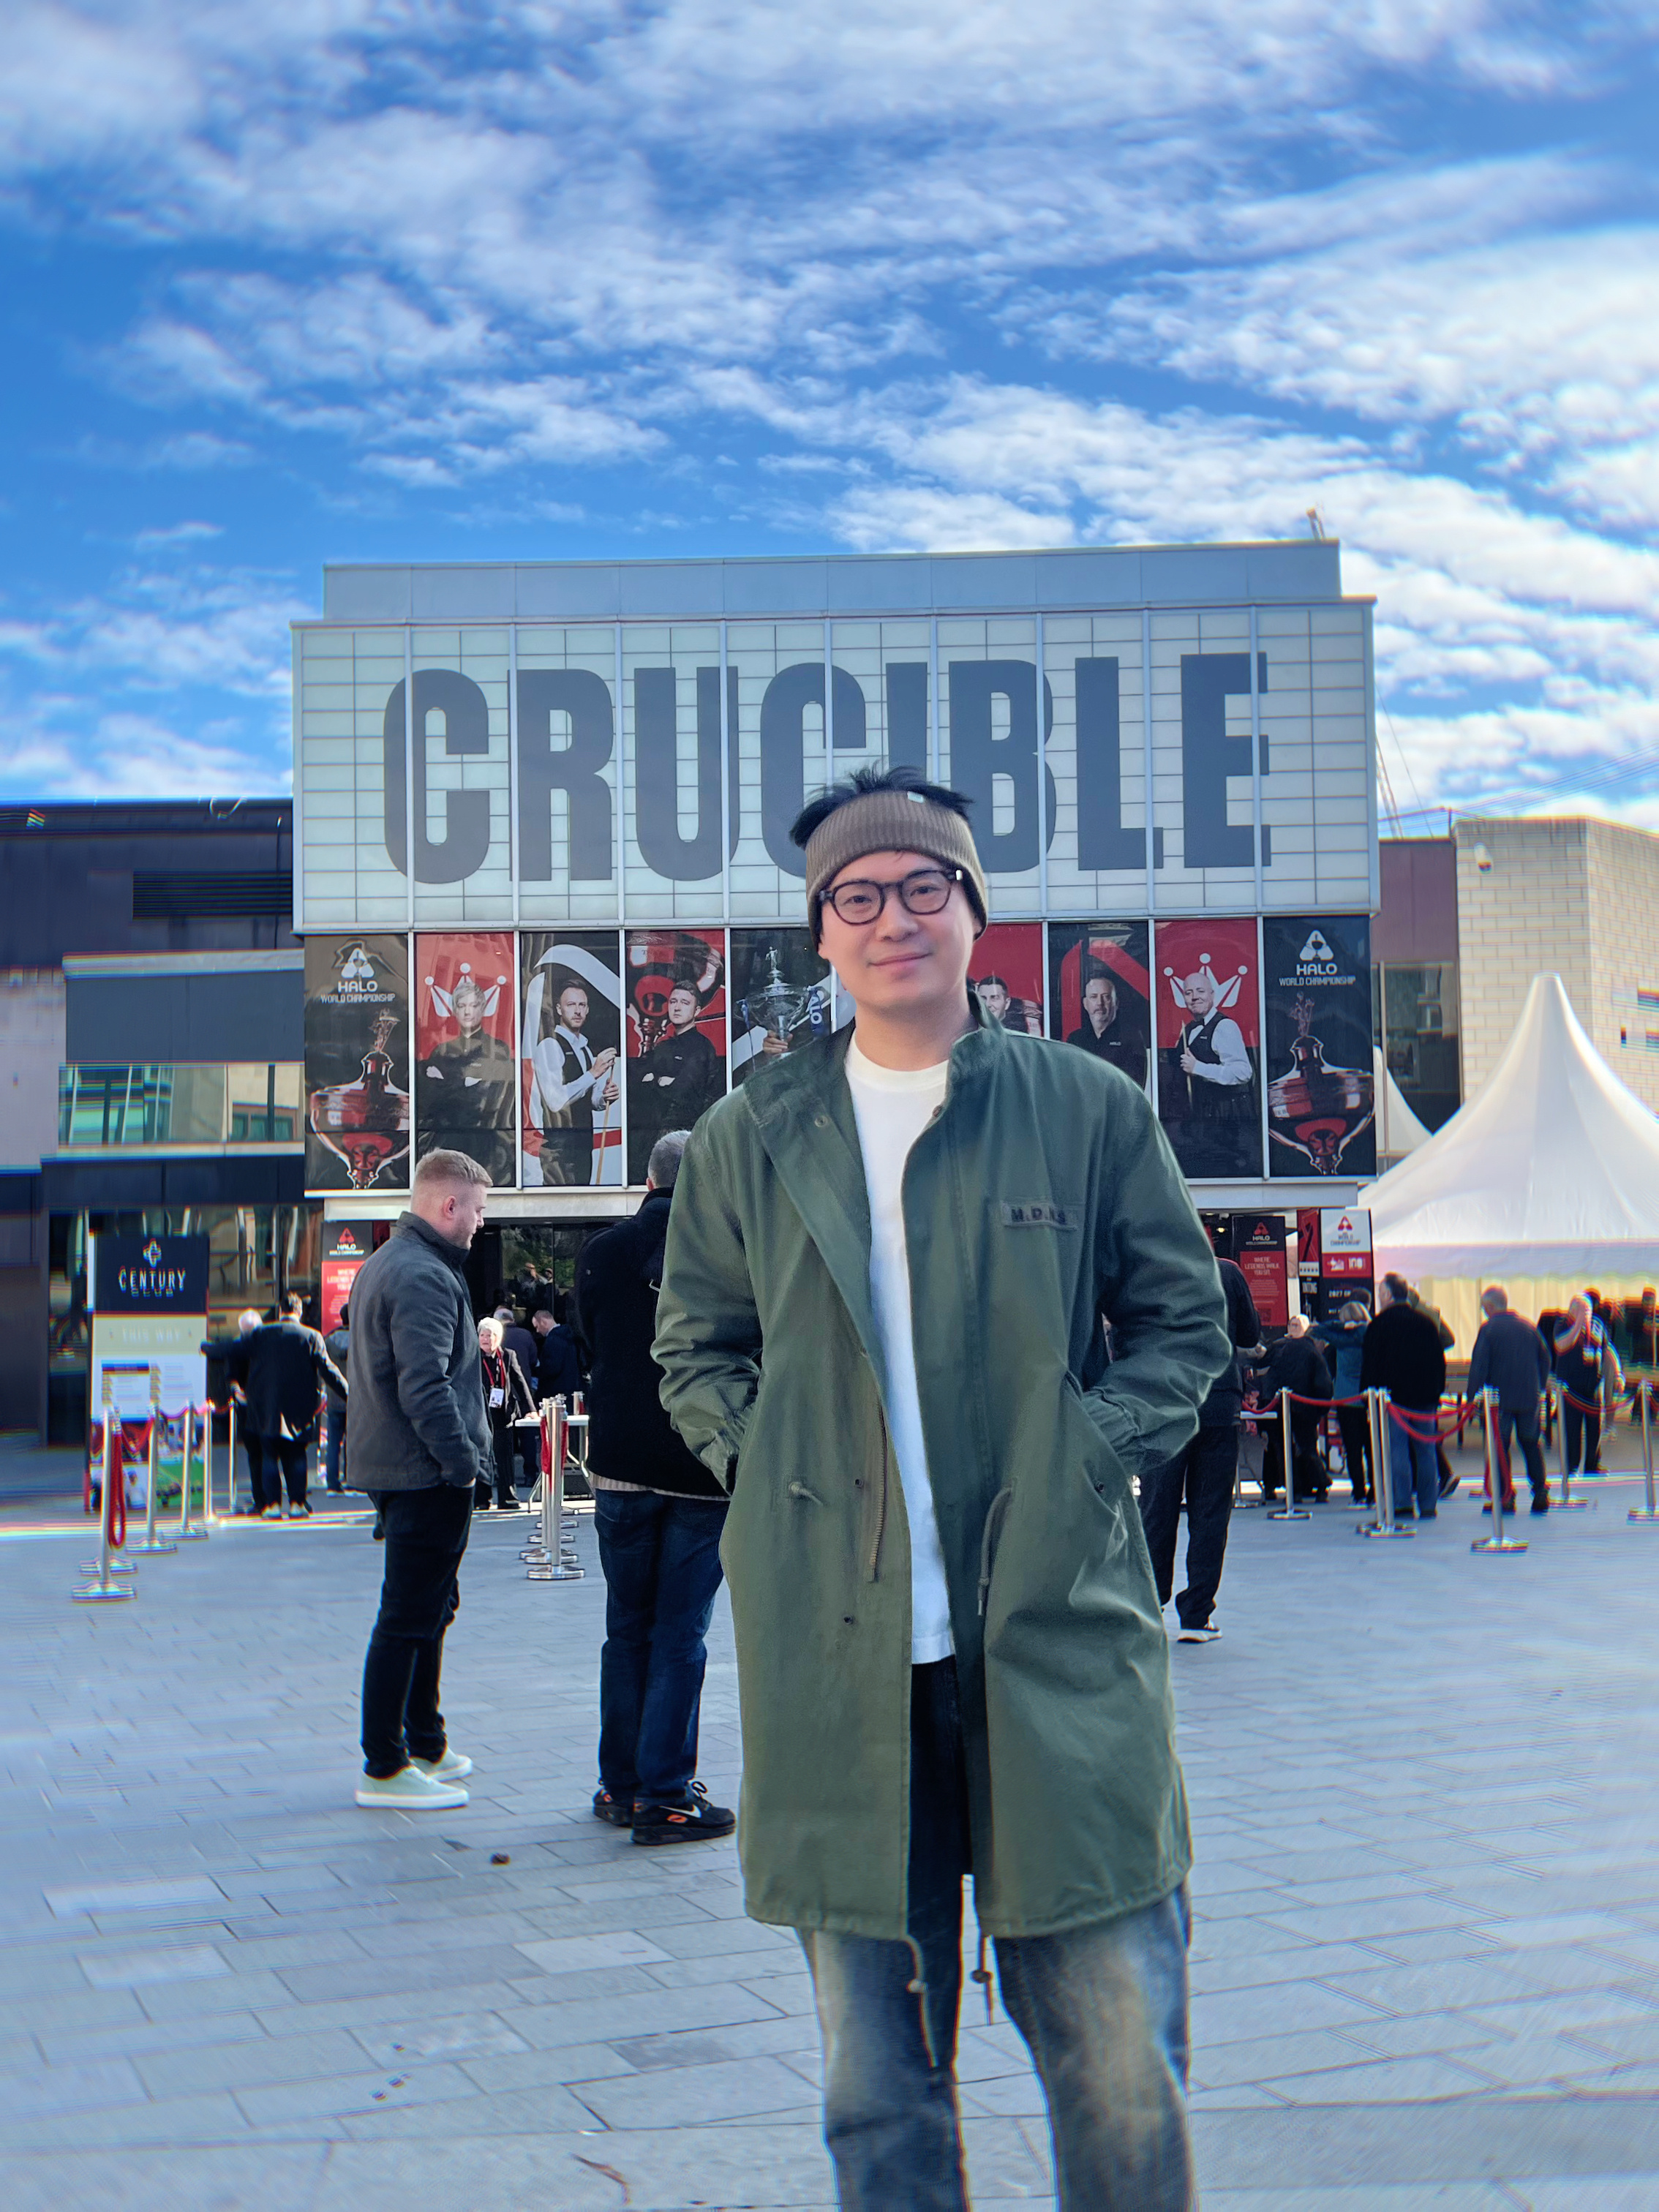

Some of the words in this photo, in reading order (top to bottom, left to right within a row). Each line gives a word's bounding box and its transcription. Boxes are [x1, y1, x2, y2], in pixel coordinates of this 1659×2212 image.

[384, 652, 1271, 884] CRUCIBLE
[1296, 963, 1338, 975] HALO
[338, 980, 378, 993] HALO
[1279, 977, 1304, 986] WORLD
[1305, 975, 1356, 986] CHAMPIONSHIP
[320, 993, 345, 1004] WORLD
[346, 993, 396, 1004] CHAMPIONSHIP
[336, 1243, 356, 1251] HALO
[118, 1266, 186, 1293] CENTURY
